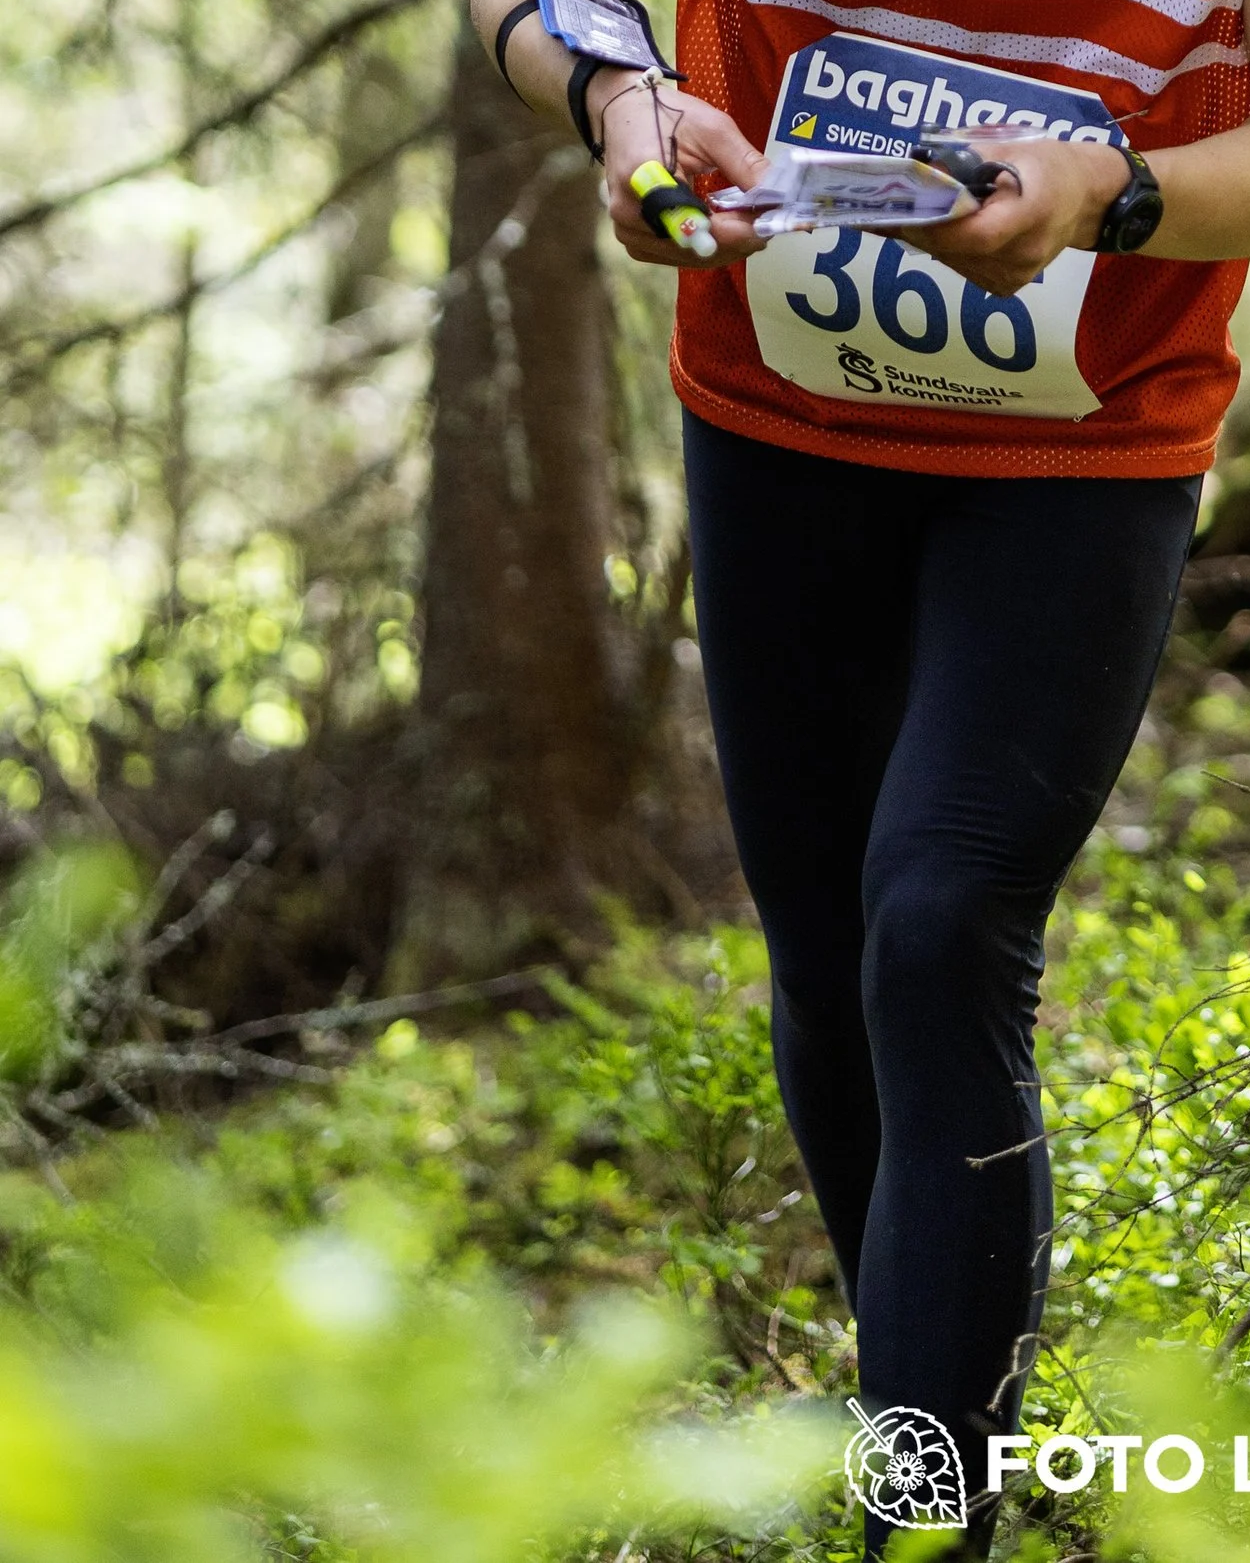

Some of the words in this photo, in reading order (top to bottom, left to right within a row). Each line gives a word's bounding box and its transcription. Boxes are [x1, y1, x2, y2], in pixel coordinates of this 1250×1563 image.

[785, 225, 1043, 373] 366
[883, 364, 1025, 399] Sundsvalls
[888, 380, 1003, 406] kommun
